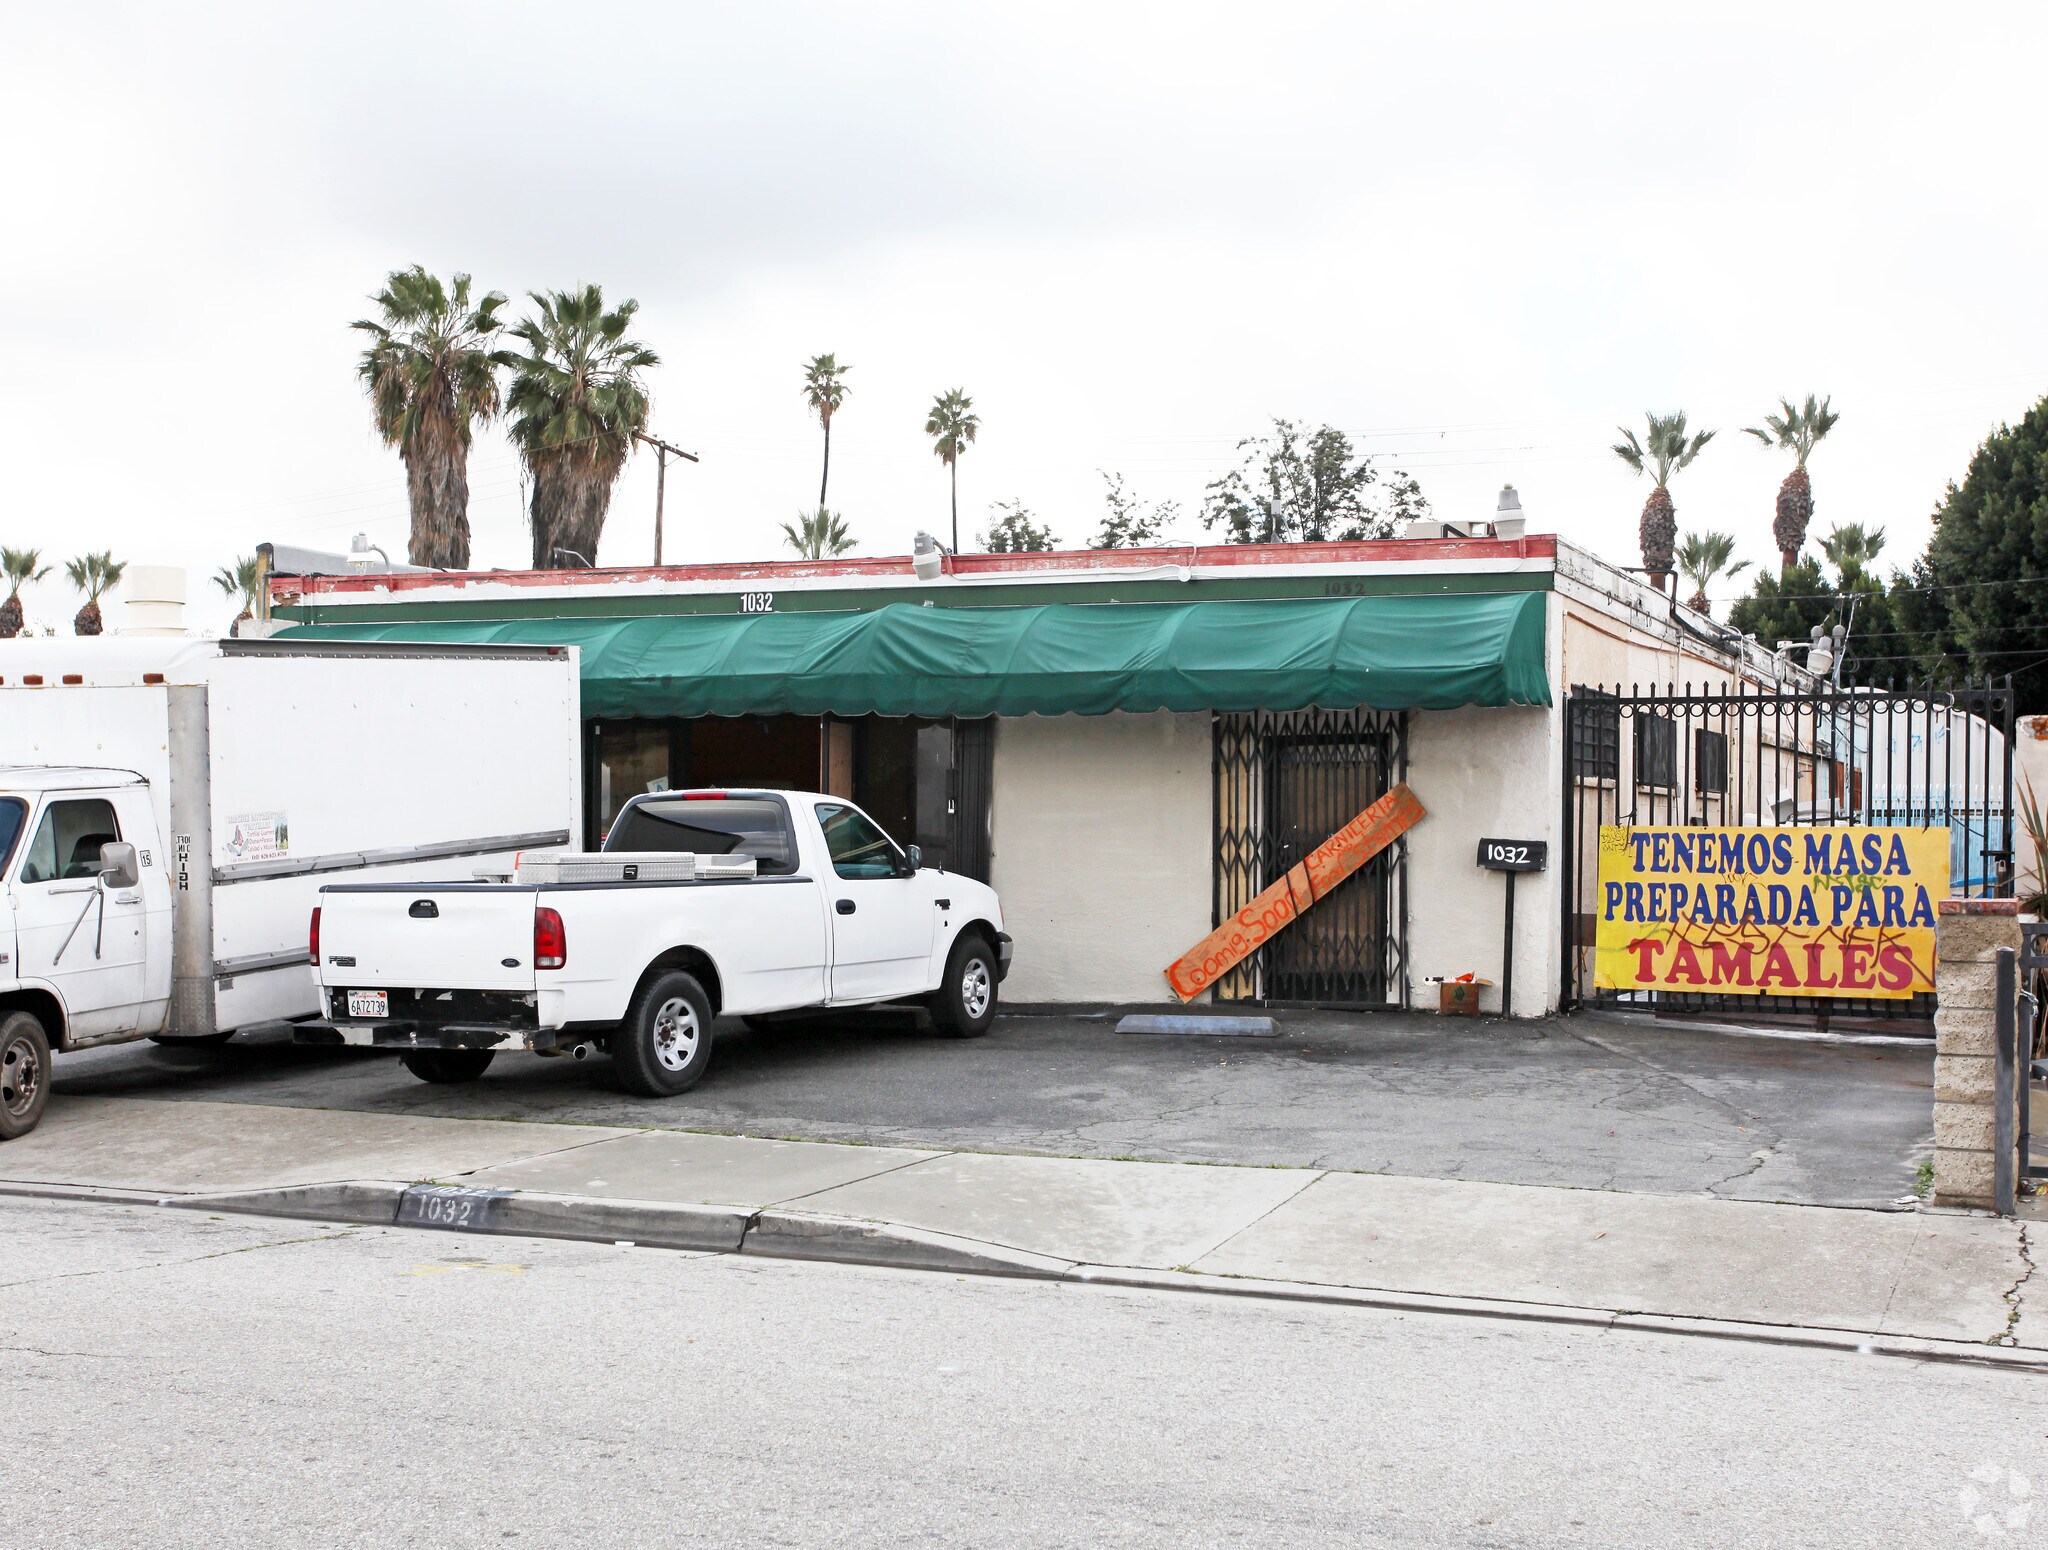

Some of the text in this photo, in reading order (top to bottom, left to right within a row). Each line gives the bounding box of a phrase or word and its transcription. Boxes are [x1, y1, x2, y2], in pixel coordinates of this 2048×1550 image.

[741, 593, 773, 612] 1032
[1324, 581, 1366, 596] 1032
[1304, 795, 1402, 871] CARNICERIA
[142, 854, 151, 865] 15
[1488, 844, 1530, 863] 1032
[1631, 832, 1792, 875] TENEMOS
[1803, 833, 1911, 875] MASA
[1238, 888, 1303, 943] Soon
[1605, 882, 1820, 927] PREPARADA
[1831, 885, 1936, 927] PARA
[1629, 938, 1914, 990] TAMALES
[351, 1000, 386, 1013] 6A72739
[418, 1194, 471, 1226] 1032
